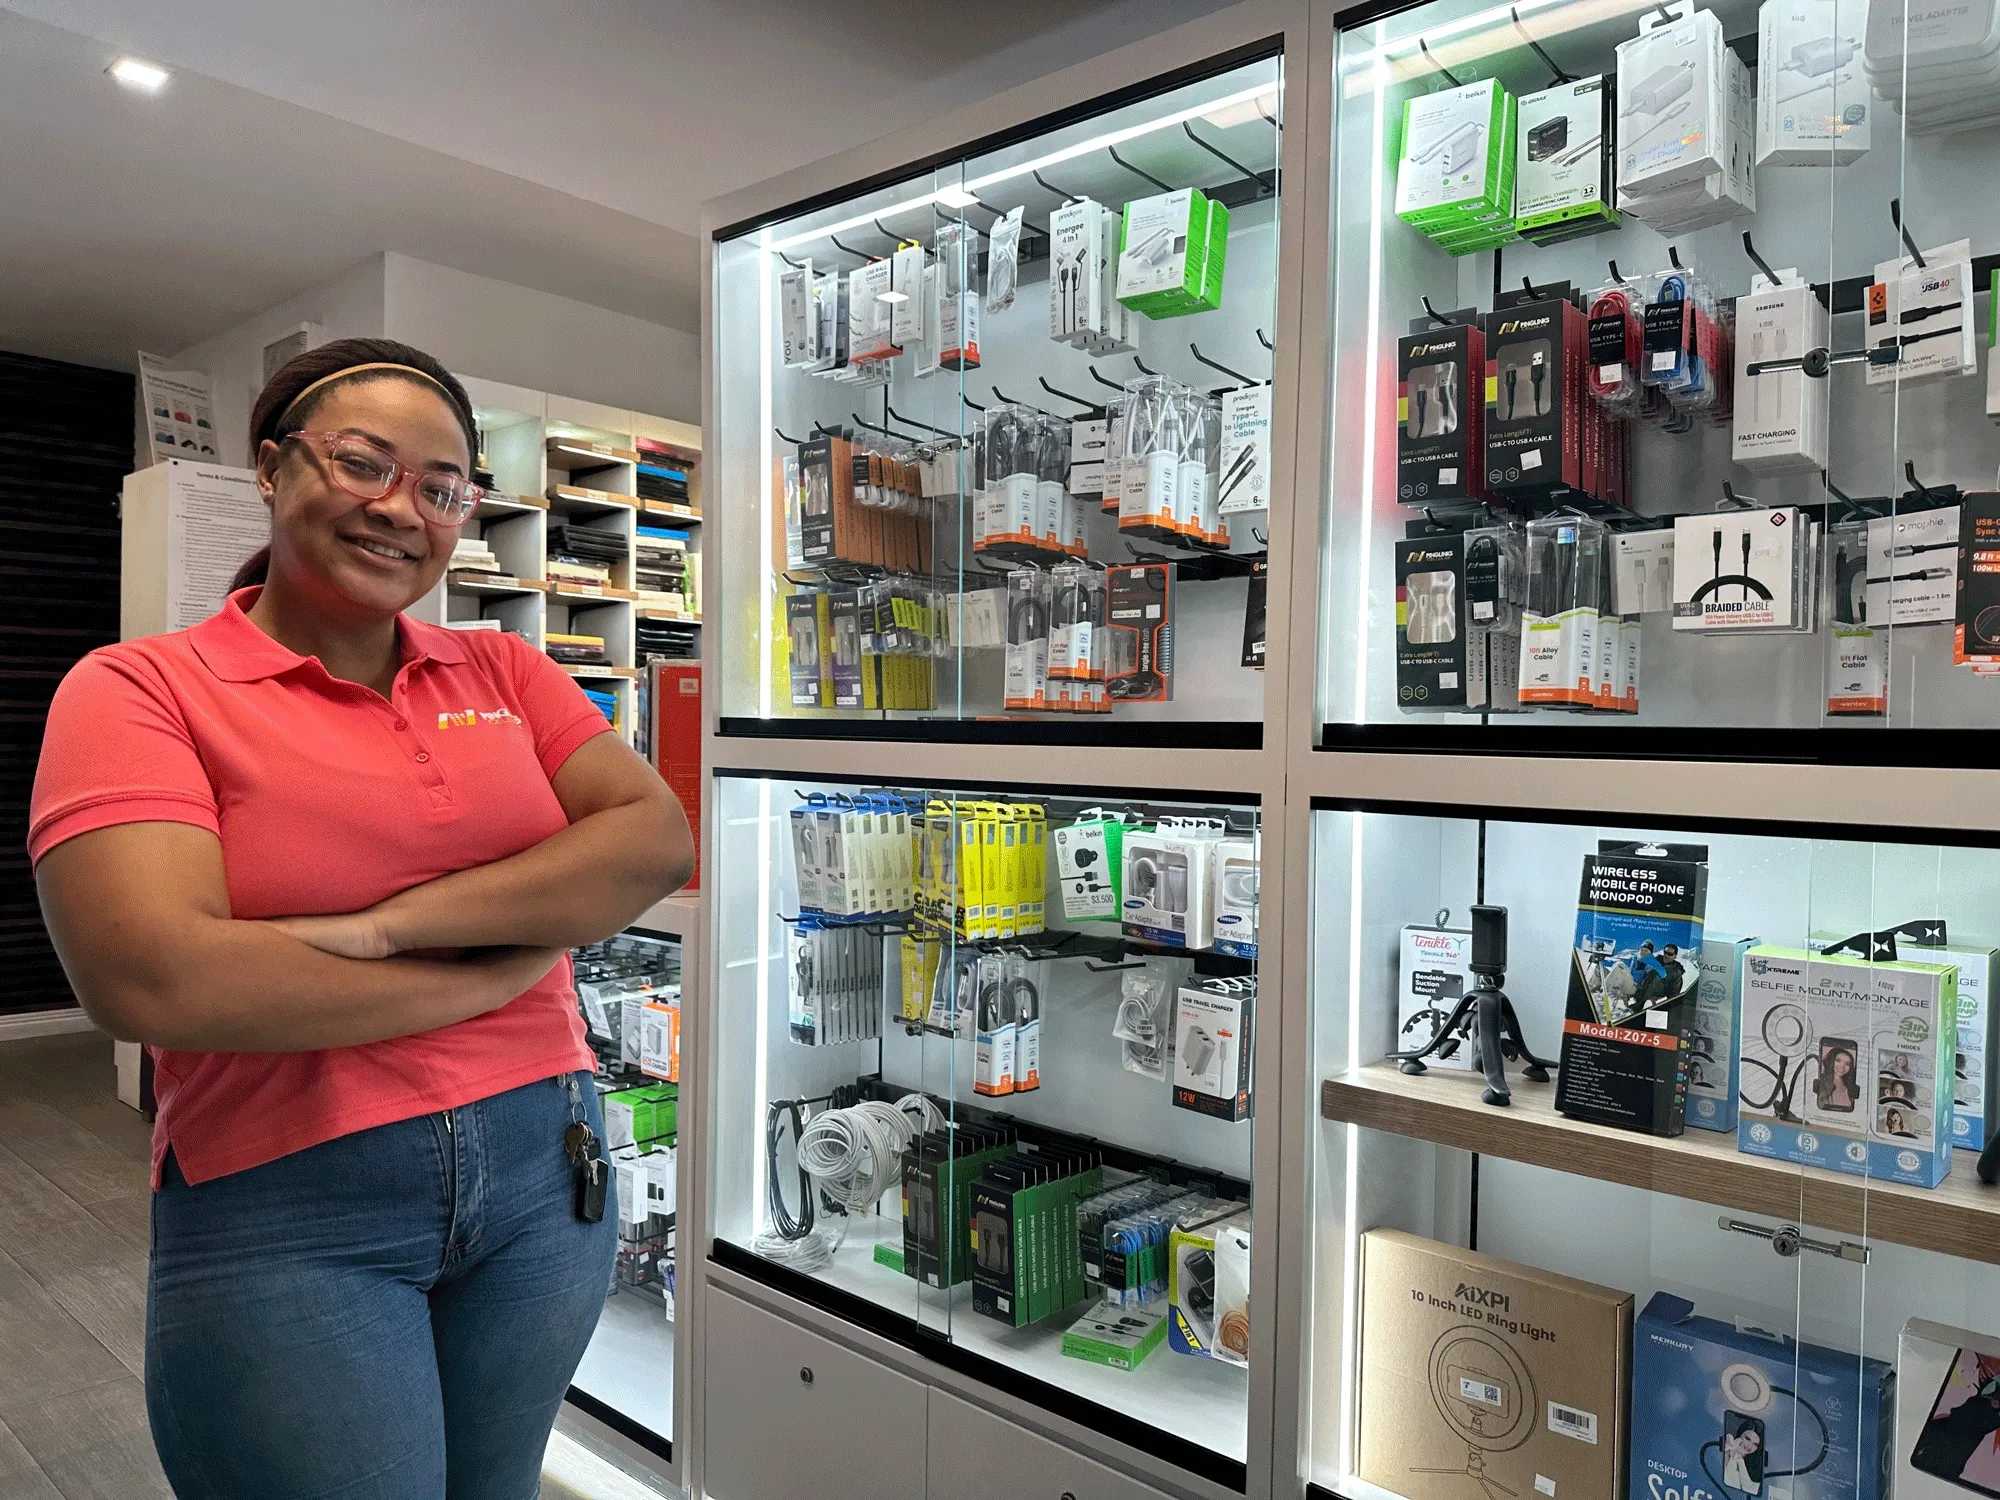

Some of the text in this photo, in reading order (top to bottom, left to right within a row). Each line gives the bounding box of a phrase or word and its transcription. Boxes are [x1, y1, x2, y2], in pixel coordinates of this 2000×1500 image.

[1465, 89, 1486, 100] belkin
[1584, 187, 1594, 195] 12
[1056, 223, 1085, 236] Energee
[1756, 302, 1785, 312] SAMSUNG
[1520, 316, 1550, 329] PINGLINKS
[1430, 342, 1457, 352] PINGLINKS
[1232, 411, 1259, 421] Type-C
[1234, 418, 1268, 431] Lightning
[1234, 430, 1256, 438] Cable
[1738, 428, 1797, 442] FAST CHARGING
[1490, 440, 1507, 449] USB-C
[1534, 434, 1553, 443] CABLE
[1976, 528, 1996, 536] Sync
[1426, 550, 1454, 558] PINGLINKS
[1973, 552, 1987, 561] 9.8
[1972, 564, 1993, 573] 100w
[1888, 597, 1912, 605] carging
[1914, 594, 1930, 602] cable
[1706, 601, 1770, 613] BRAIDED CABLE
[1468, 632, 1474, 645] TO
[1478, 632, 1484, 645] TO
[1542, 647, 1559, 655] Alloy
[1852, 654, 1868, 662] Flat
[1086, 830, 1103, 839] belkin
[1592, 866, 1658, 880] WIRELESS
[1590, 878, 1685, 895] MOBILE PHONE
[1590, 890, 1653, 905] MONOPOD
[1125, 912, 1134, 920] Car
[1218, 928, 1253, 940] Car Adapter
[1411, 934, 1452, 950] Tenikle
[1767, 967, 1800, 976] XTREME
[1416, 974, 1447, 982] Bendable
[1820, 978, 1832, 988] 2
[1416, 980, 1440, 988] Suction
[1752, 980, 1794, 993] SELFIE
[1416, 986, 1437, 994] Mount
[1193, 999, 1210, 1008] TRAVEL
[1210, 1002, 1234, 1012] CHARGER
[1898, 1031, 1930, 1043] RING
[1178, 1090, 1196, 1104] 12W
[1411, 1288, 1557, 1344] 10 Inch LED Ring Light
[1651, 1334, 1694, 1351] MERKURY
[1648, 1460, 1688, 1480] DESKTOP
